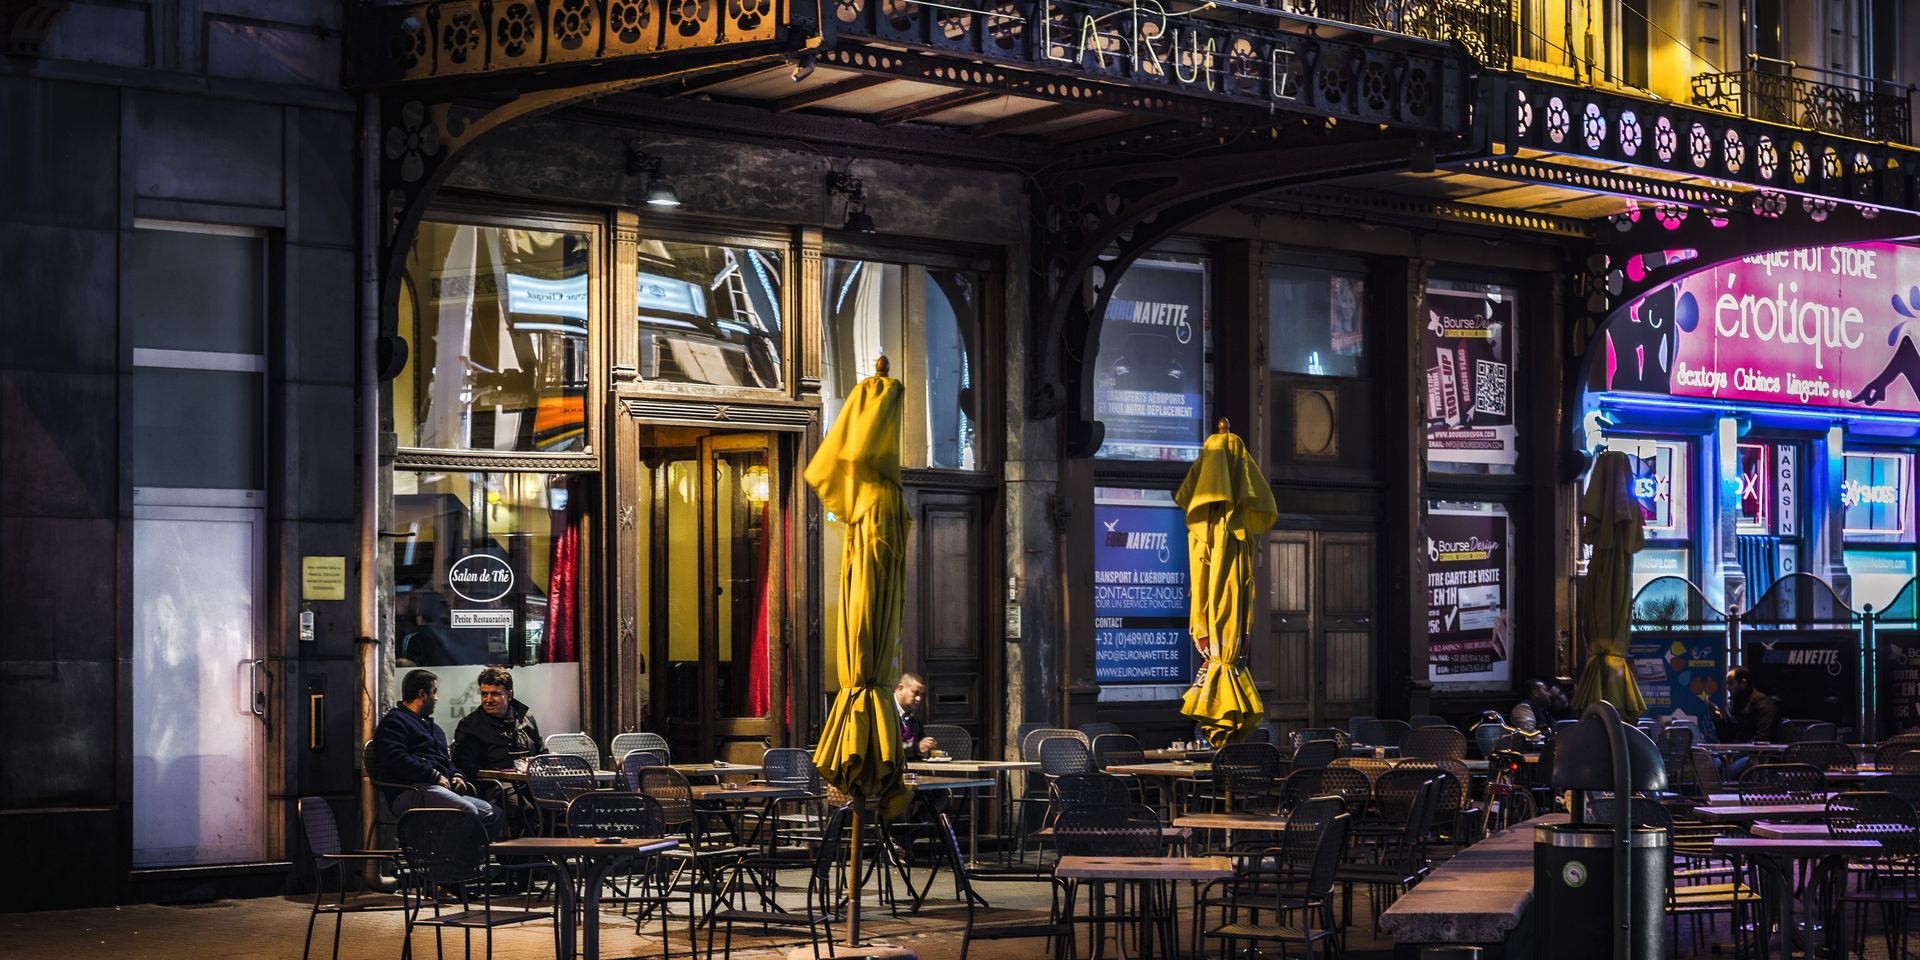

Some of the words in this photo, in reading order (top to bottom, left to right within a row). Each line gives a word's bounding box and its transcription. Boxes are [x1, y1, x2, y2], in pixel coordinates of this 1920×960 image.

[1131, 0, 1296, 100] RUCE
[1831, 246, 1877, 279] STORE
[1716, 273, 1864, 369] érotique
[1442, 354, 1458, 419] ROLL-UP
[1461, 372, 1471, 402] BEACH
[1677, 362, 1728, 398] Sextoys
[1734, 368, 1780, 393] Cabines
[1107, 391, 1147, 403] TRANSFERTS
[1149, 391, 1185, 405] AÉROPORTS
[1108, 402, 1125, 414] TOUT
[1126, 403, 1146, 415] AUTRE
[1147, 402, 1193, 417] DÉPLACEMENT
[1781, 445, 1792, 533] MAGASIN
[452, 568, 478, 582] Salon
[480, 568, 491, 582] de
[492, 568, 510, 582] Thé
[1133, 569, 1139, 583] À
[1140, 570, 1179, 584] L'AÉROPORT
[1180, 572, 1185, 584] ?
[1445, 570, 1467, 586] CARTE
[1468, 570, 1477, 584] DE
[1478, 568, 1500, 582] VISITE
[1112, 600, 1122, 609] UN
[1123, 600, 1147, 609] SERVICE
[1149, 600, 1183, 609] PONCTUEL
[1433, 587, 1445, 606] EN
[1446, 586, 1457, 605] 1H
[454, 614, 472, 624] Petite
[473, 614, 510, 624] Restauration
[1095, 617, 1123, 628] CONTACT
[1096, 632, 1113, 645] +32
[1115, 631, 1179, 649] (0)489/00.85.27
[1096, 650, 1179, 661] INFO@EURONAVETTE.BE
[1096, 666, 1179, 677] WWW.EURONAVETTE.BE
